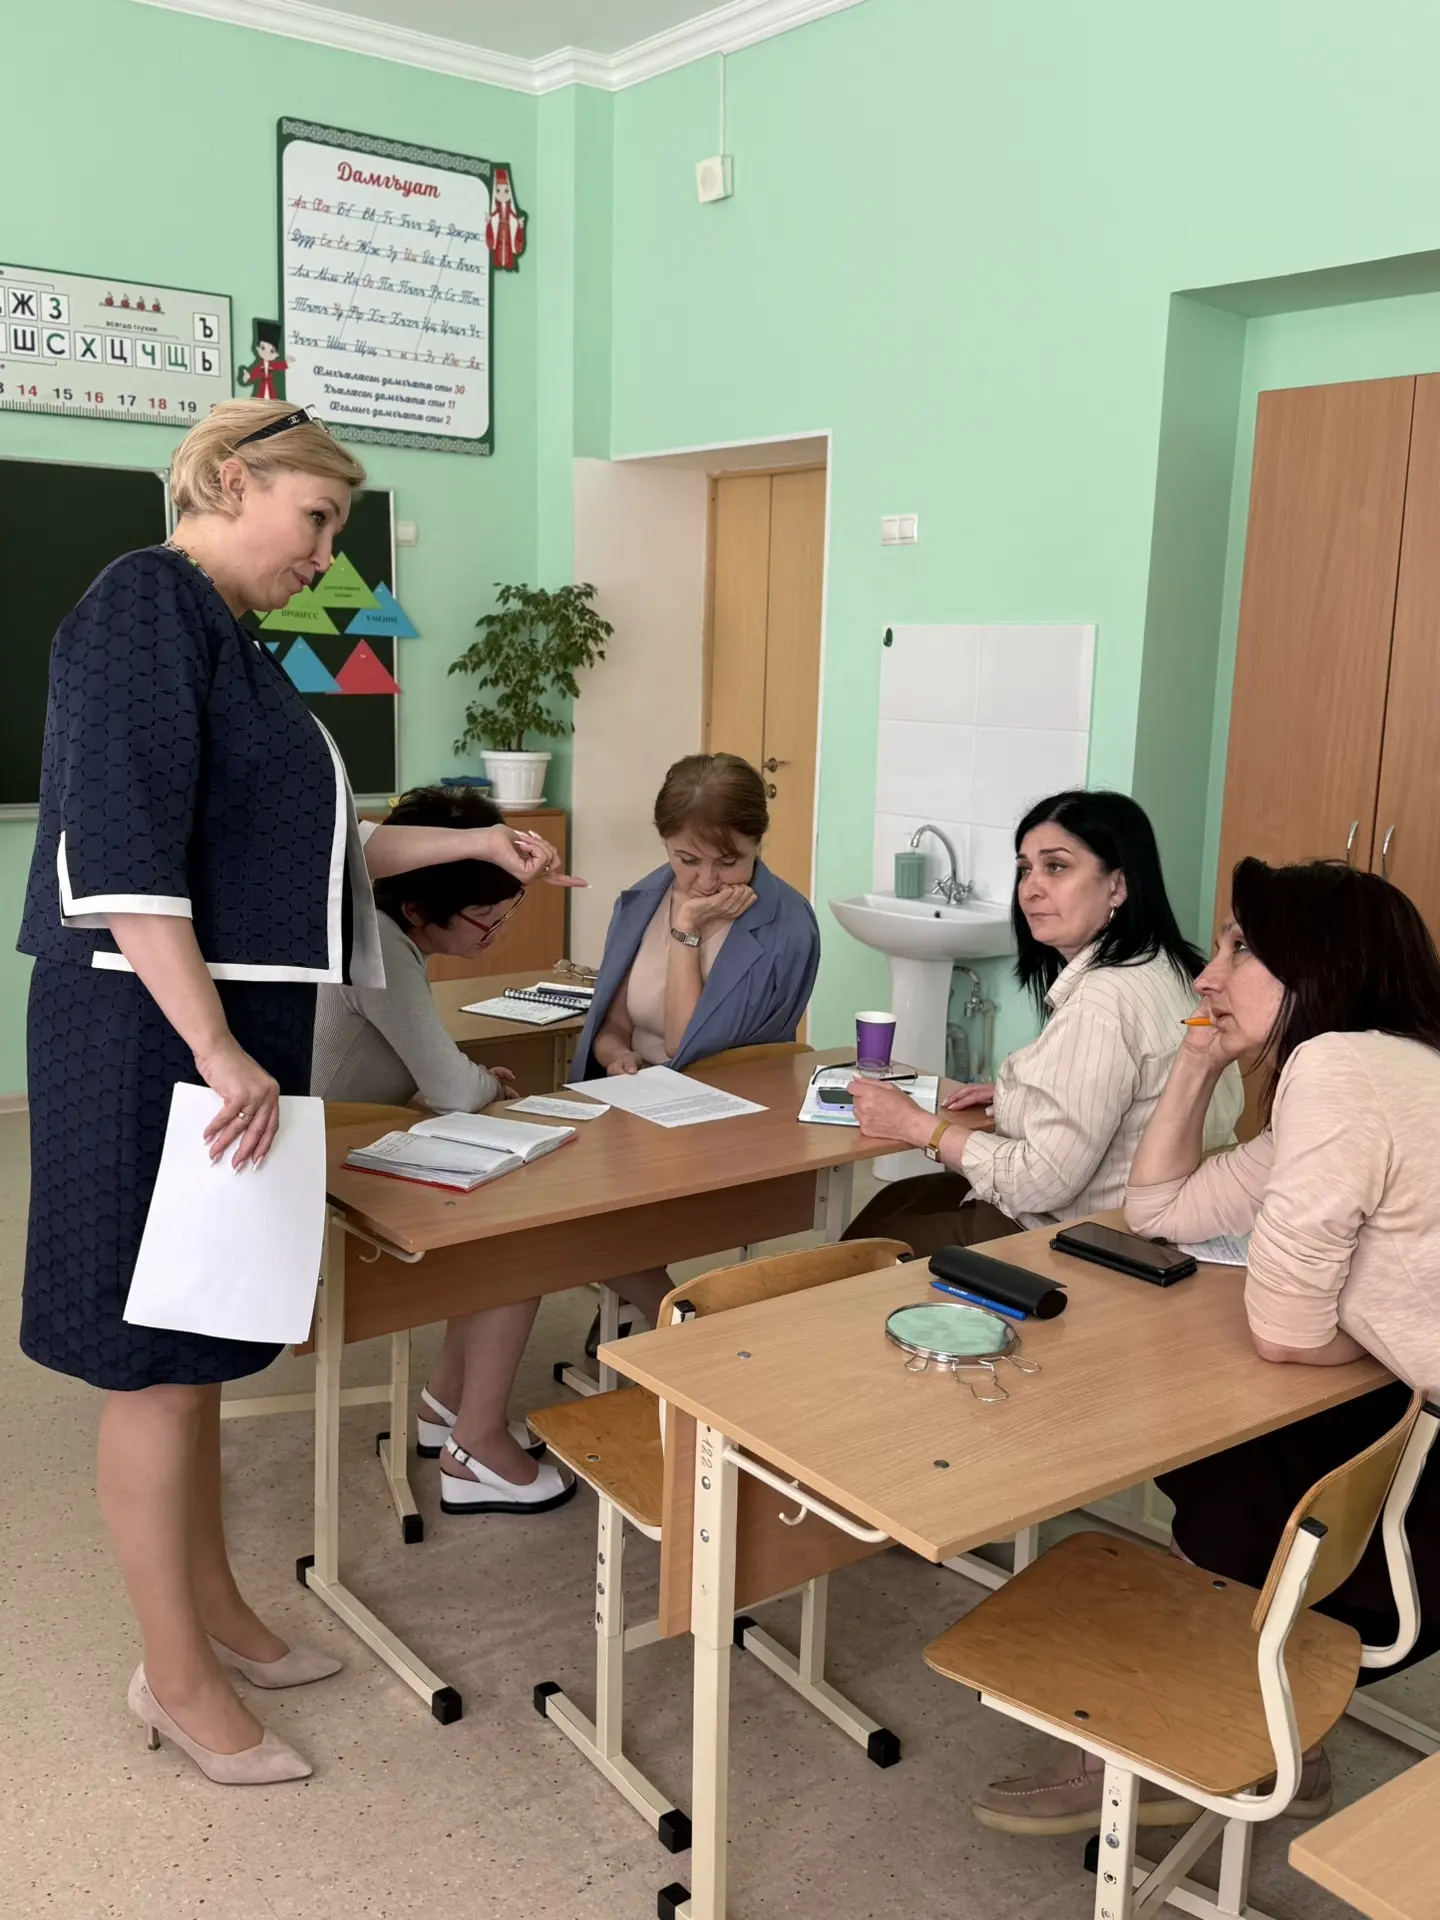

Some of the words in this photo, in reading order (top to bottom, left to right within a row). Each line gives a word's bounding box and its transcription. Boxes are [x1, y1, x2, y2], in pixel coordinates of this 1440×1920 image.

[336, 161, 441, 199] Дамгъуат
[11, 291, 36, 317] Ж
[48, 296, 63, 321] З
[199, 316, 214, 339] Ъ
[13, 328, 36, 352] Ш
[46, 332, 66, 356] С
[80, 336, 98, 359] Х
[110, 338, 128, 364] Ц
[141, 343, 156, 366] Ч
[167, 345, 188, 371] Щ
[17, 384, 38, 397] 14
[52, 388, 74, 401] 15
[84, 391, 105, 404] 16
[117, 394, 137, 407] 17
[148, 397, 168, 410] 18
[178, 400, 197, 413] 19
[454, 384, 466, 396] 30
[447, 399, 456, 410] 11
[445, 415, 452, 426] 2
